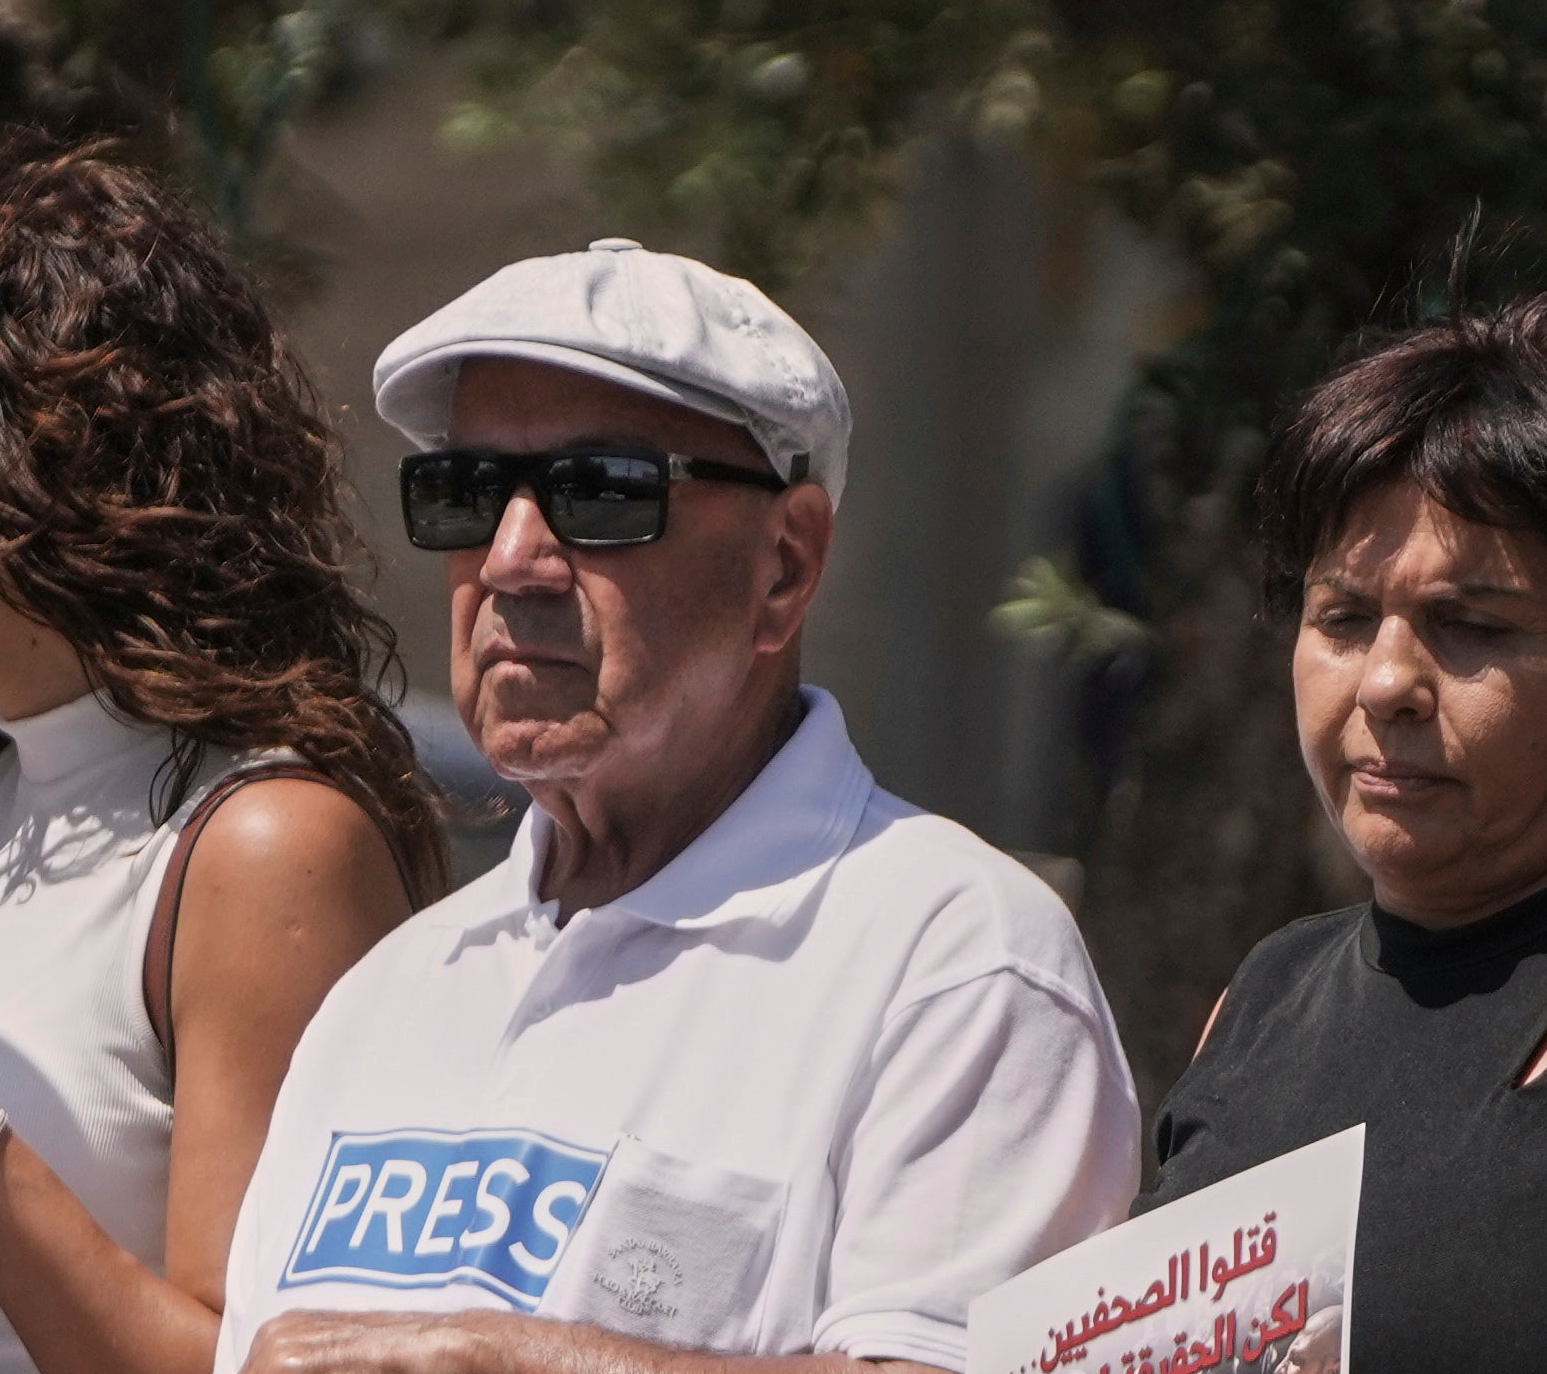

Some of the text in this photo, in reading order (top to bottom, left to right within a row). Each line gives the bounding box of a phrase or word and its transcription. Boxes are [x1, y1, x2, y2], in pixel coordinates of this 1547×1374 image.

[305, 1157, 587, 1277] PRESS
[1199, 1210, 1277, 1302] قتلوا
[1242, 1278, 1309, 1364] لكن
